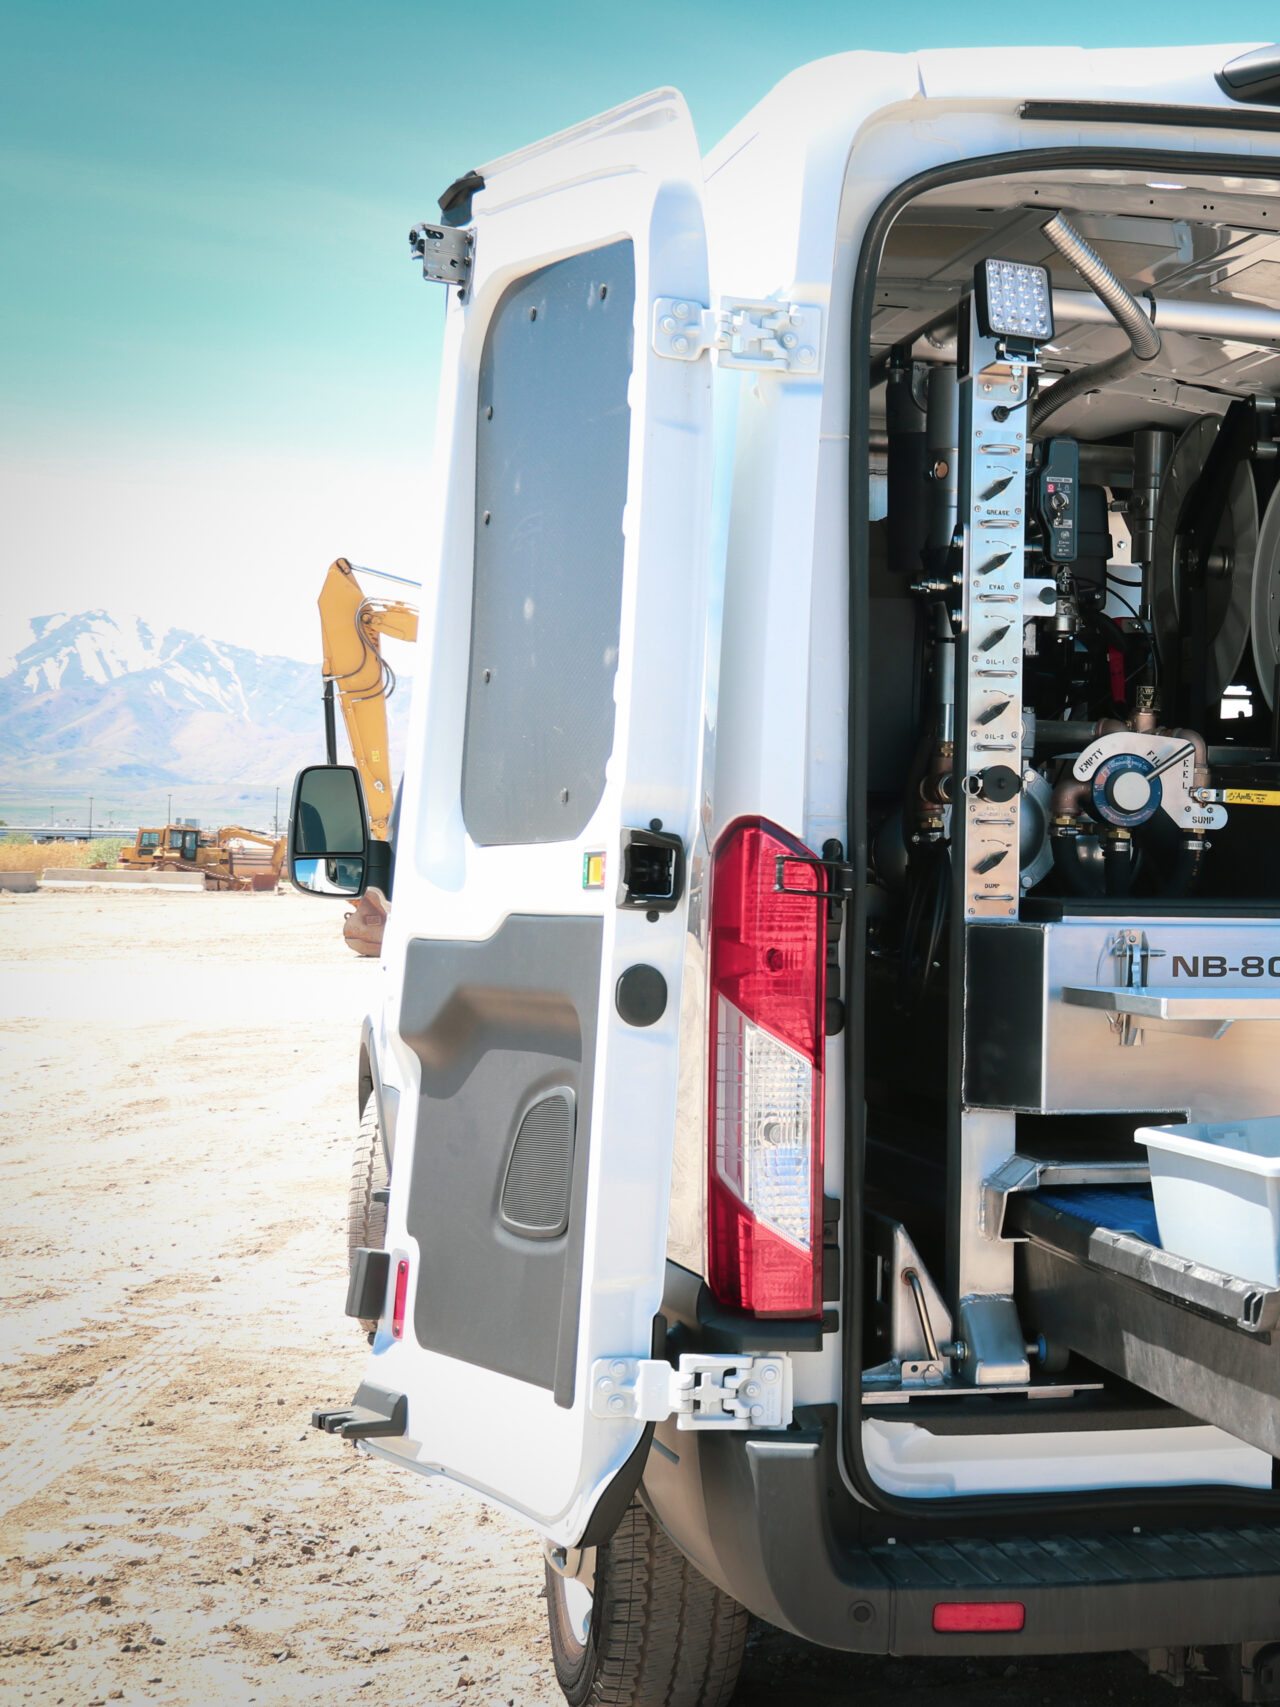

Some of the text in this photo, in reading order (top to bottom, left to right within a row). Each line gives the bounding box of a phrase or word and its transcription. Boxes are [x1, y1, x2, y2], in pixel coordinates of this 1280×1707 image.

[1078, 748, 1104, 774] EMPTY
[1146, 750, 1160, 769] FIL
[1191, 815, 1215, 825] SUMP
